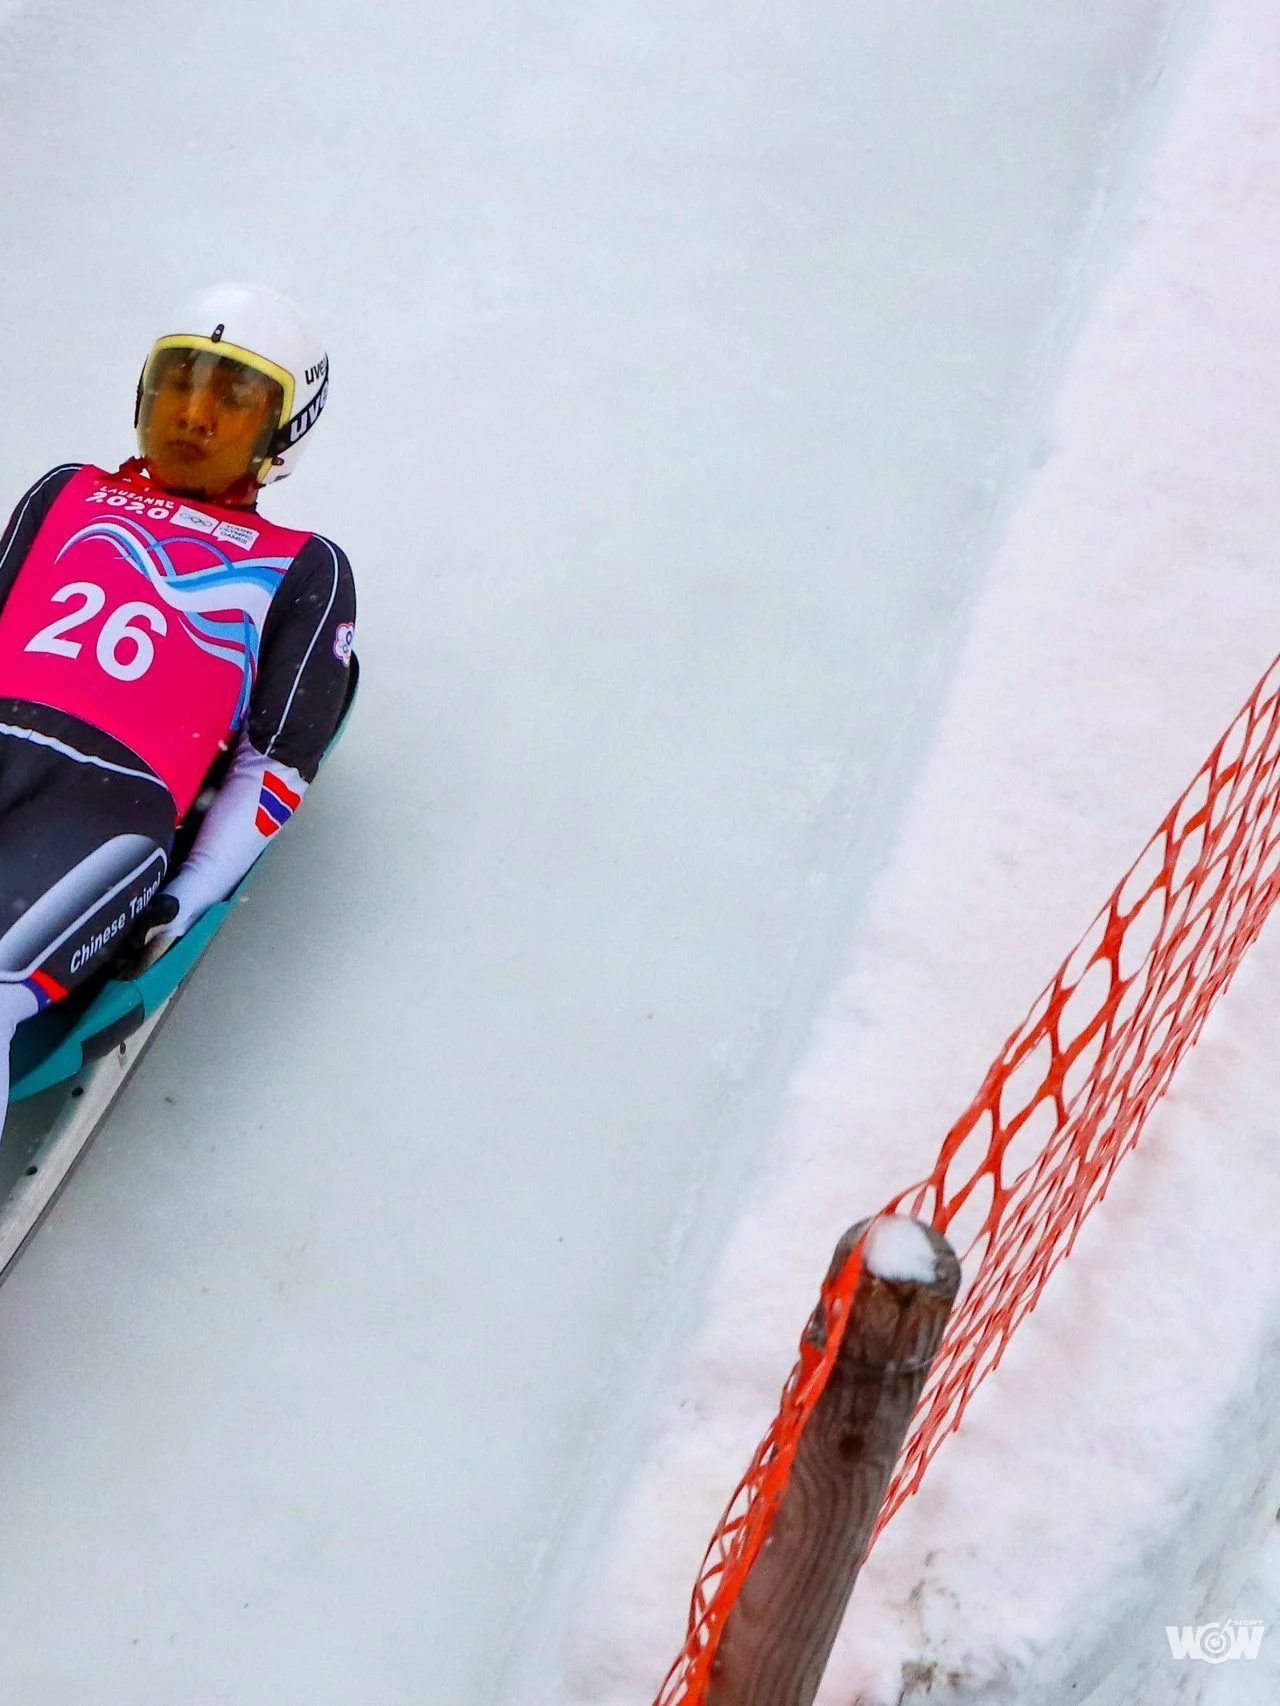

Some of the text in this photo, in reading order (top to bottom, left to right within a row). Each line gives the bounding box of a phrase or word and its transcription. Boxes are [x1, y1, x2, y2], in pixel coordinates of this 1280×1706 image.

[304, 356, 327, 385] uve
[85, 491, 170, 520] 2020
[99, 485, 175, 509] LAUSANNE
[23, 581, 168, 682] 26
[70, 912, 126, 973] Chinese
